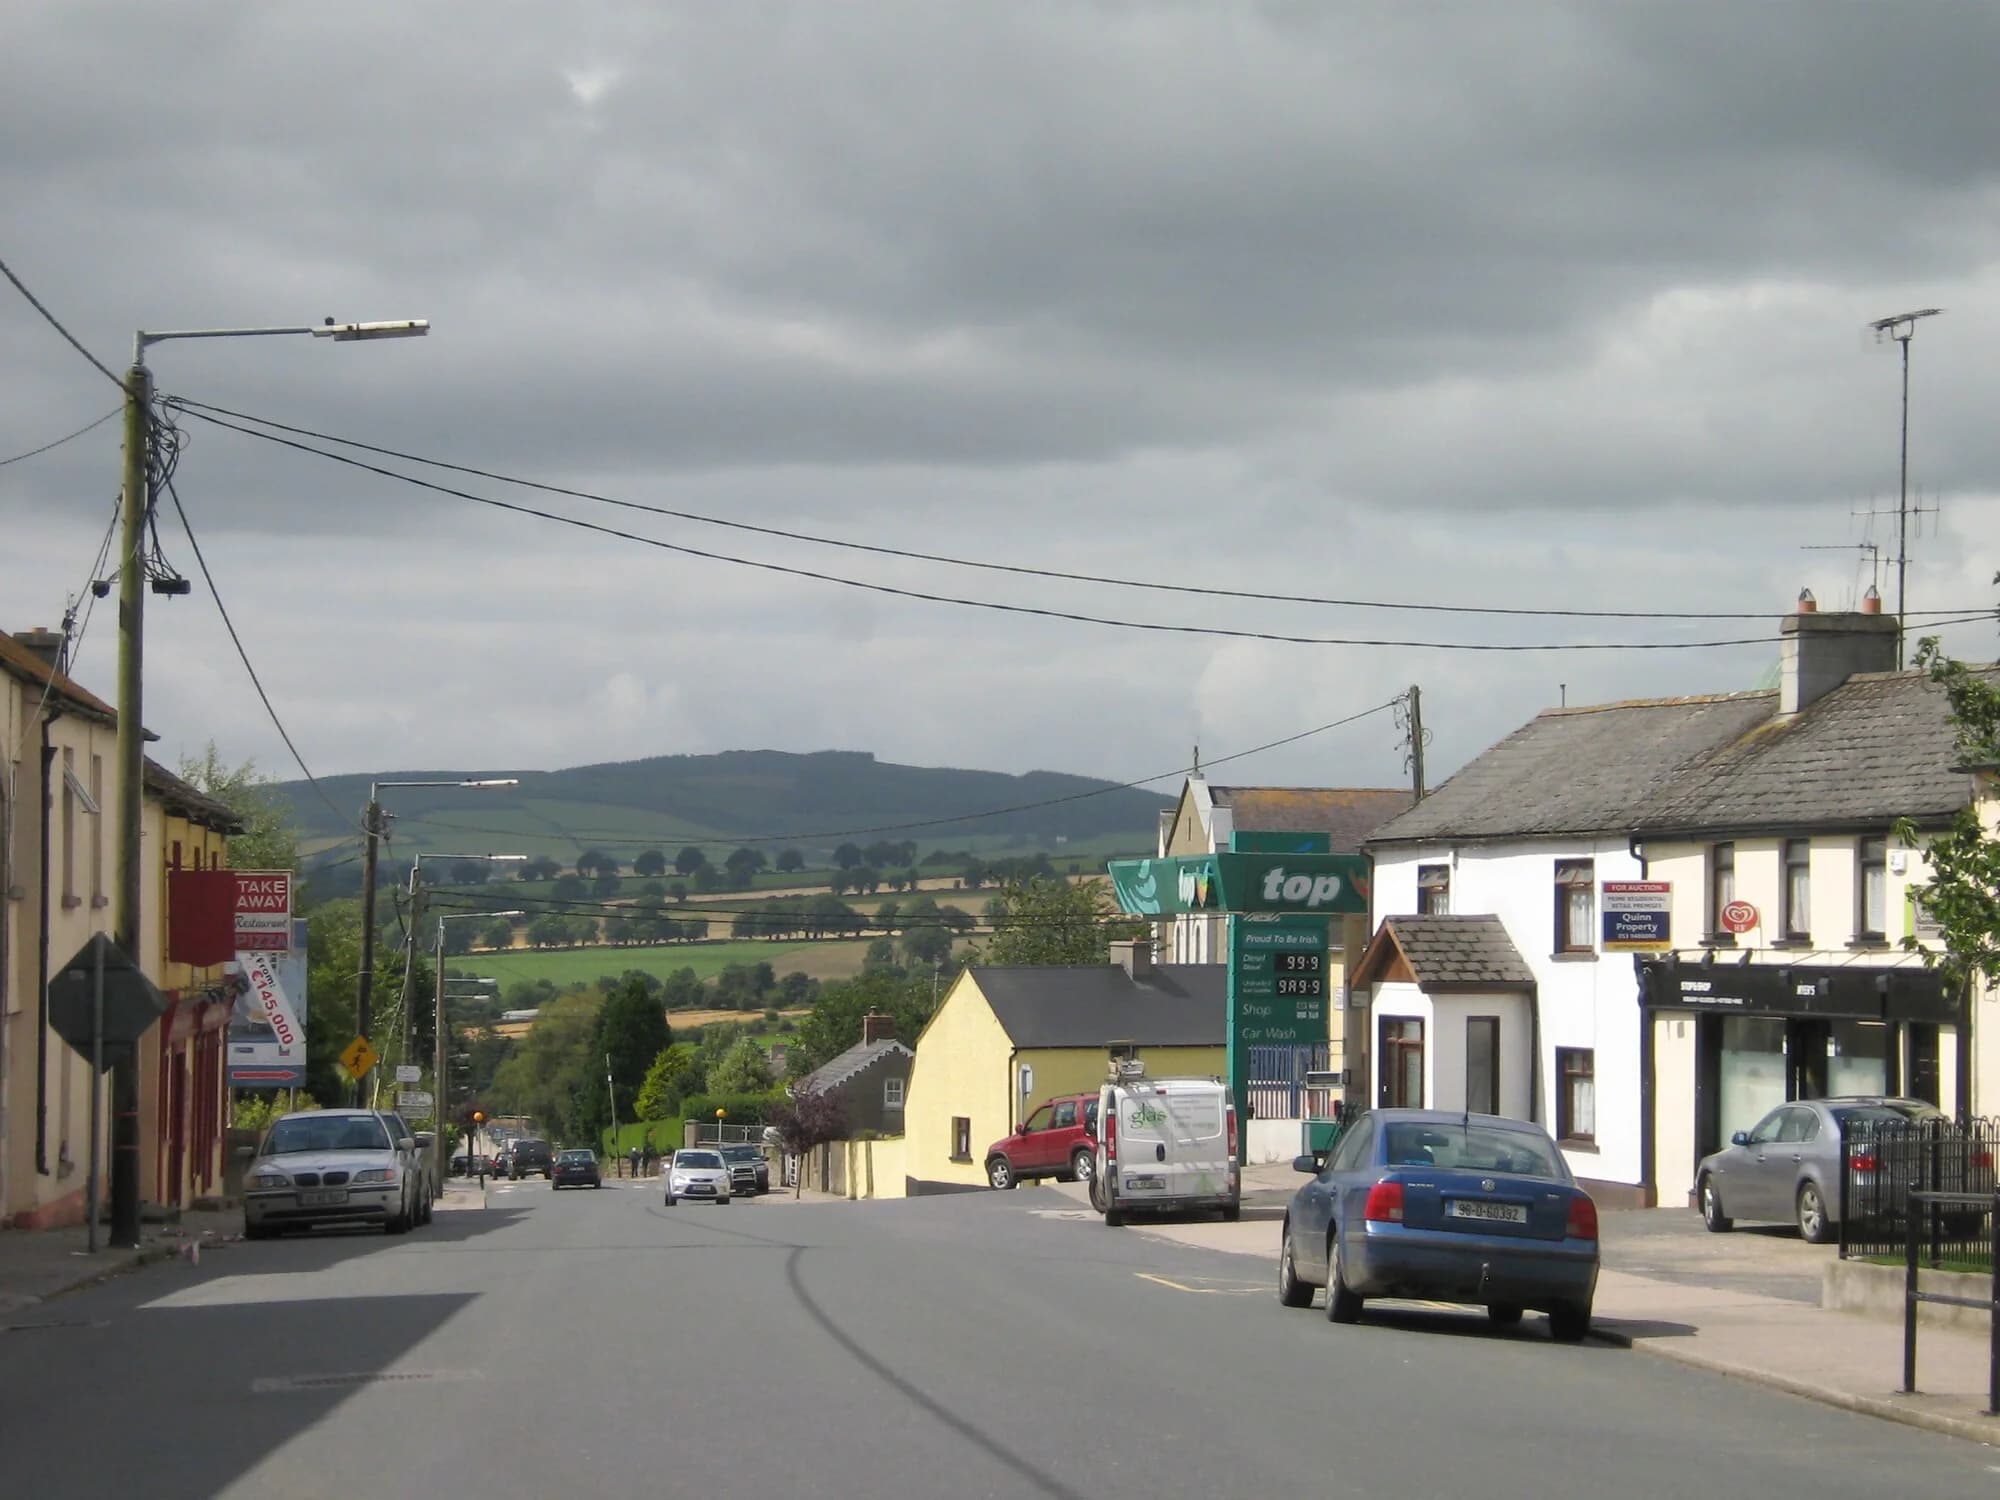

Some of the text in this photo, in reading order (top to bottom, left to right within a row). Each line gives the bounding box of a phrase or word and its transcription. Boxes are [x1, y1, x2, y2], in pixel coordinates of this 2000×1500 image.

[236, 880, 286, 893] TAKE
[1263, 867, 1341, 907] top
[236, 895, 286, 908] AWAY
[1622, 913, 1652, 923] Quinn
[1616, 923, 1658, 933] Property
[235, 933, 288, 948] PIZZA
[1246, 934, 1318, 943] Proud To Be Irish
[256, 957, 276, 988] From:
[251, 970, 294, 1045] €145,000
[1242, 1003, 1272, 1018] Shop
[1242, 1027, 1296, 1039] Car Wash
[1130, 1103, 1168, 1129] glas
